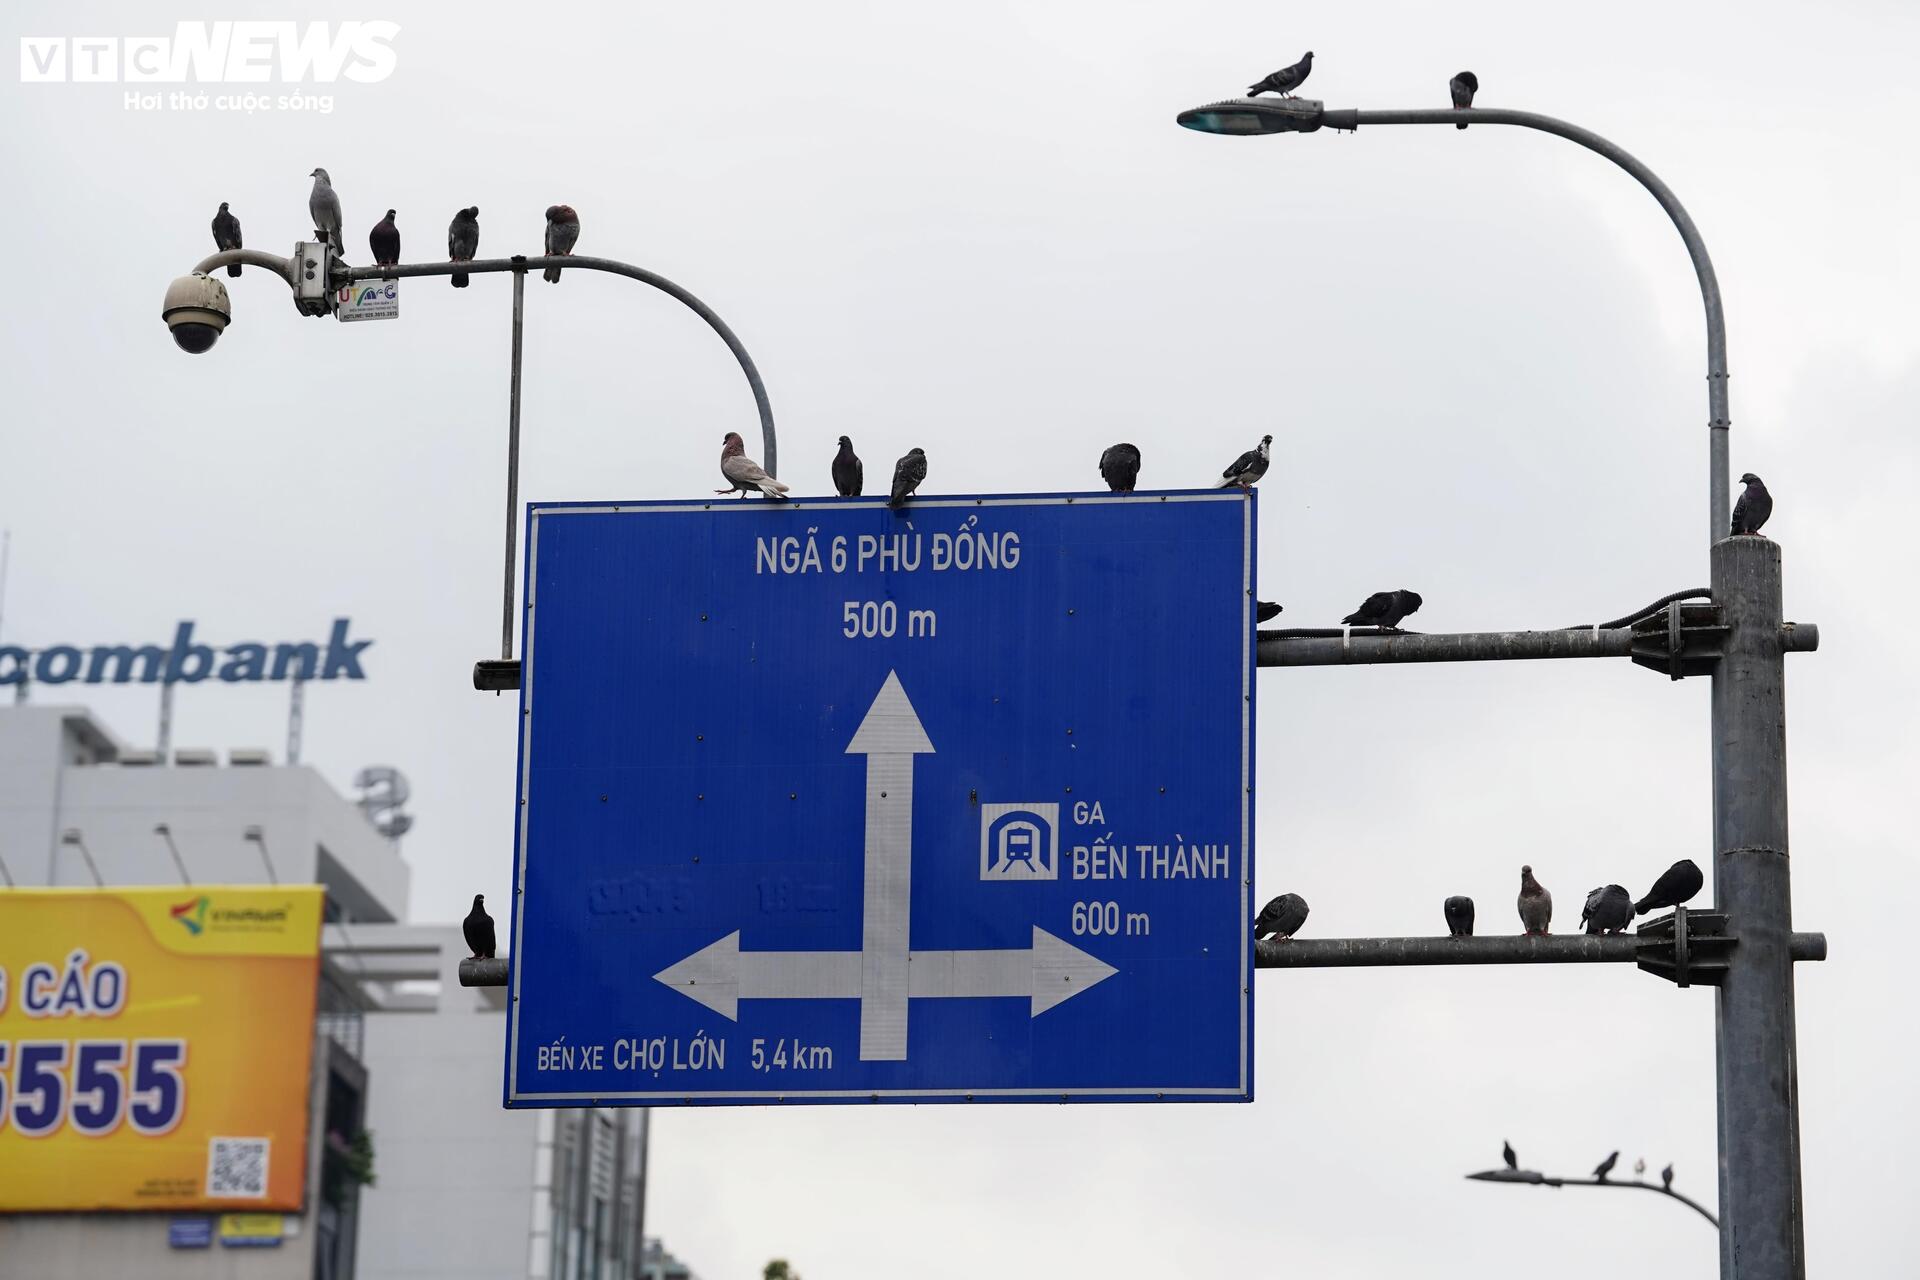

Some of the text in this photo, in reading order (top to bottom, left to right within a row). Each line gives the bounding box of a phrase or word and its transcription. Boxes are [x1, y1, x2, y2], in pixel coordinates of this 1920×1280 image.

[756, 514, 1020, 574] NGÃ 6 PHÙ ĐỔNG
[843, 600, 936, 639] 500 m
[0, 618, 372, 685] combank
[1073, 801, 1105, 825] GA
[1071, 831, 1229, 881] BẾN THÀNH
[1071, 901, 1150, 936] 600 m
[25, 955, 121, 1011] CÁO
[538, 1036, 575, 1071] BẾN
[580, 1046, 604, 1070] XE
[612, 1036, 666, 1078] CHỢ
[673, 1030, 725, 1070] LỚN
[792, 1038, 833, 1070] km
[0, 1044, 184, 1131] 555
